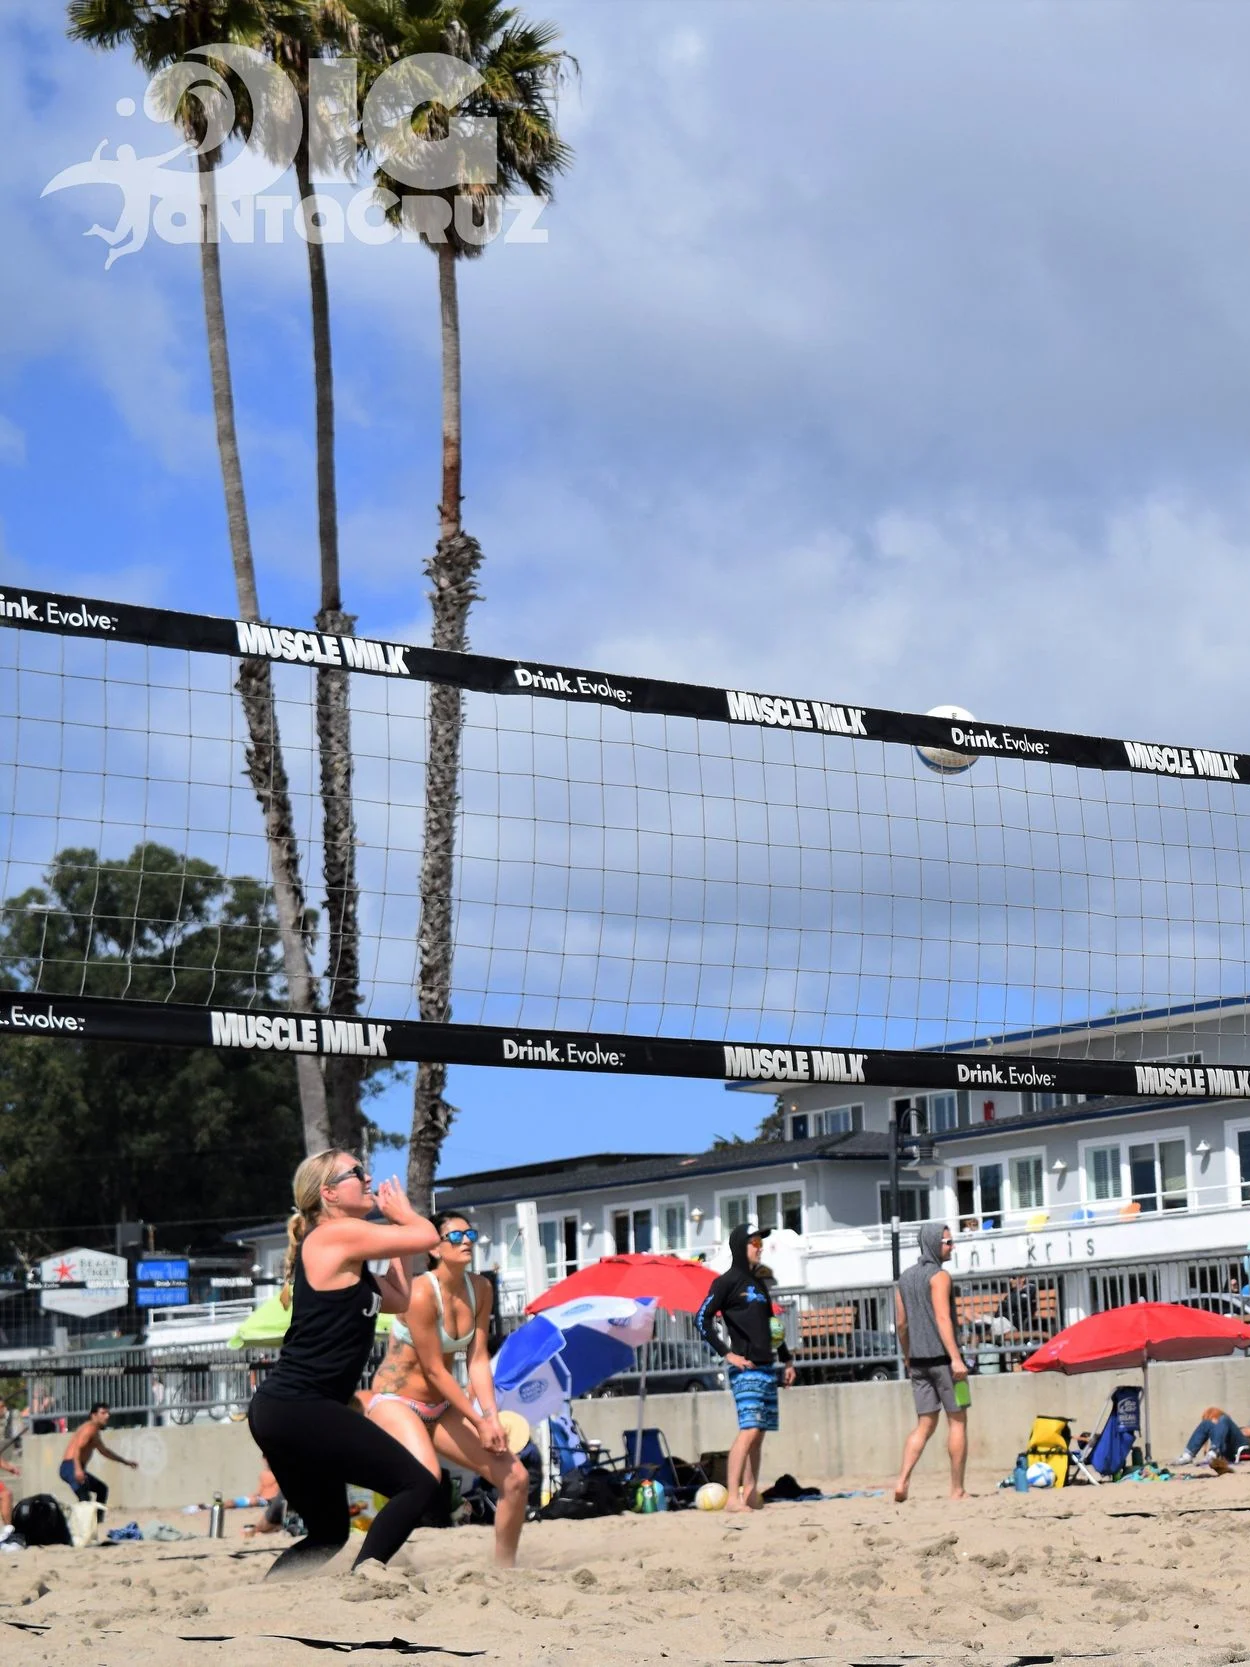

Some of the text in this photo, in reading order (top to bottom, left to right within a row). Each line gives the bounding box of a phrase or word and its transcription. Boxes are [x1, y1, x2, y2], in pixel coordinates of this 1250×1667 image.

[0, 593, 44, 621] ink.
[235, 621, 410, 675] MUSCLE MILK
[726, 690, 867, 736] MUSCLE MILK
[1124, 741, 1239, 780] MUSCLE MILK
[210, 1010, 388, 1057] MUSCLE MILK
[724, 1045, 866, 1083] MUSCLE MILK
[1135, 1065, 1205, 1096] MUSCLE
[953, 1243, 996, 1269] int
[1027, 1232, 1095, 1261] kris
